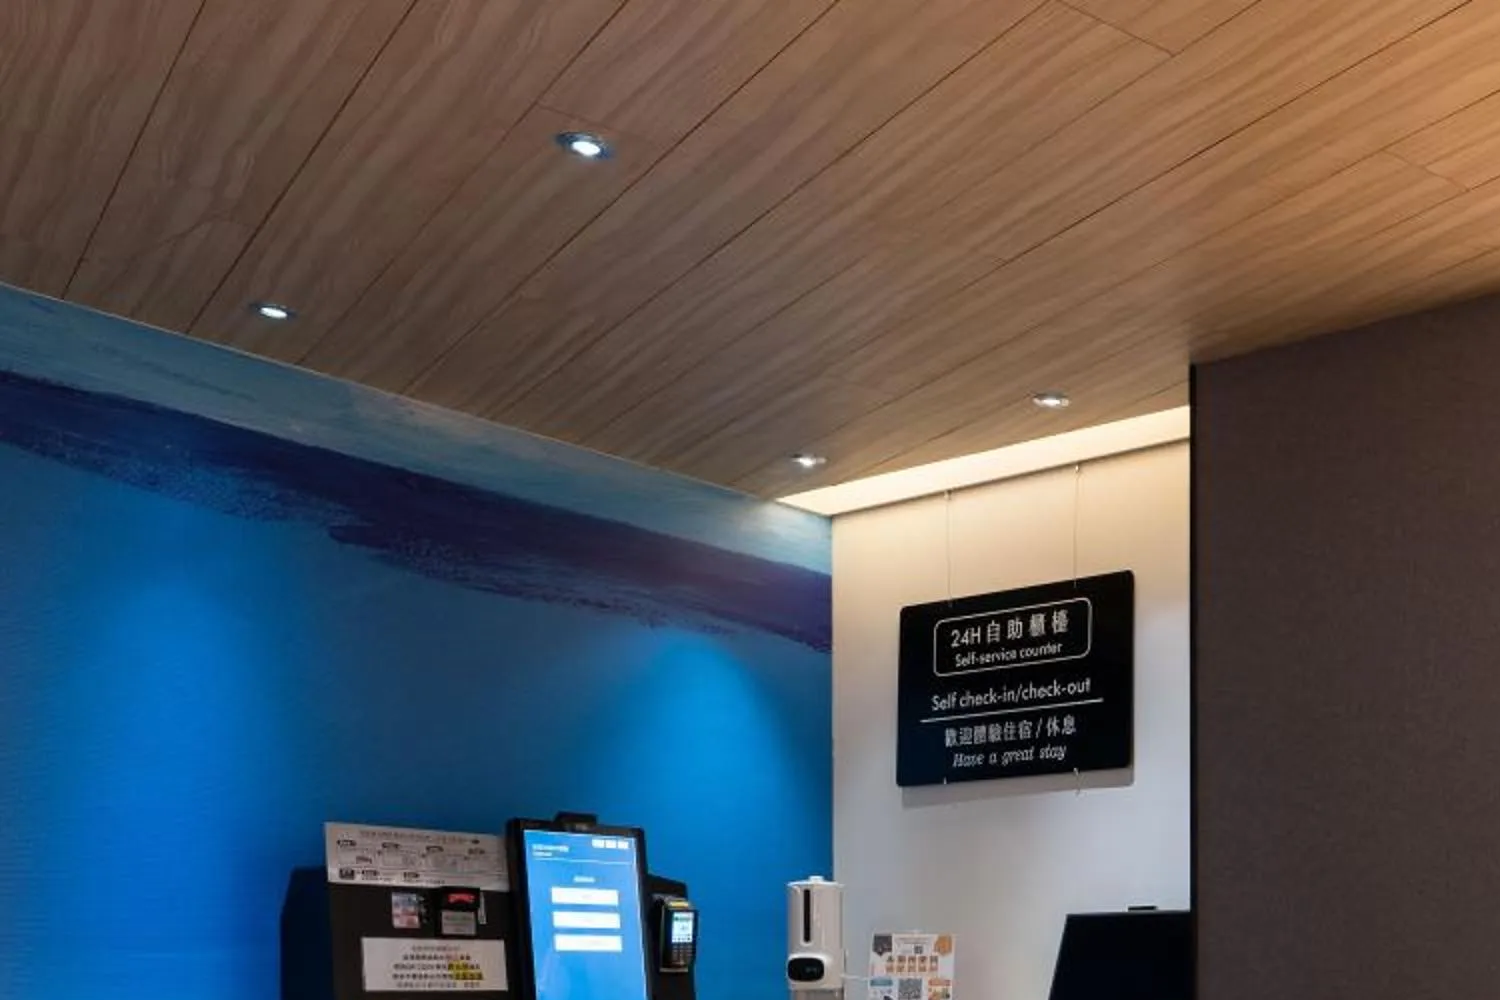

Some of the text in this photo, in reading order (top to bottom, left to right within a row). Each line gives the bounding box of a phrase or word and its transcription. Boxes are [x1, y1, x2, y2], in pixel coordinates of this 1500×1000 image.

[950, 625, 982, 648] 24H
[954, 643, 1063, 668] Self-service counter
[931, 677, 1092, 711] Self check-in/check-out
[952, 743, 1068, 768] Have a great stay
